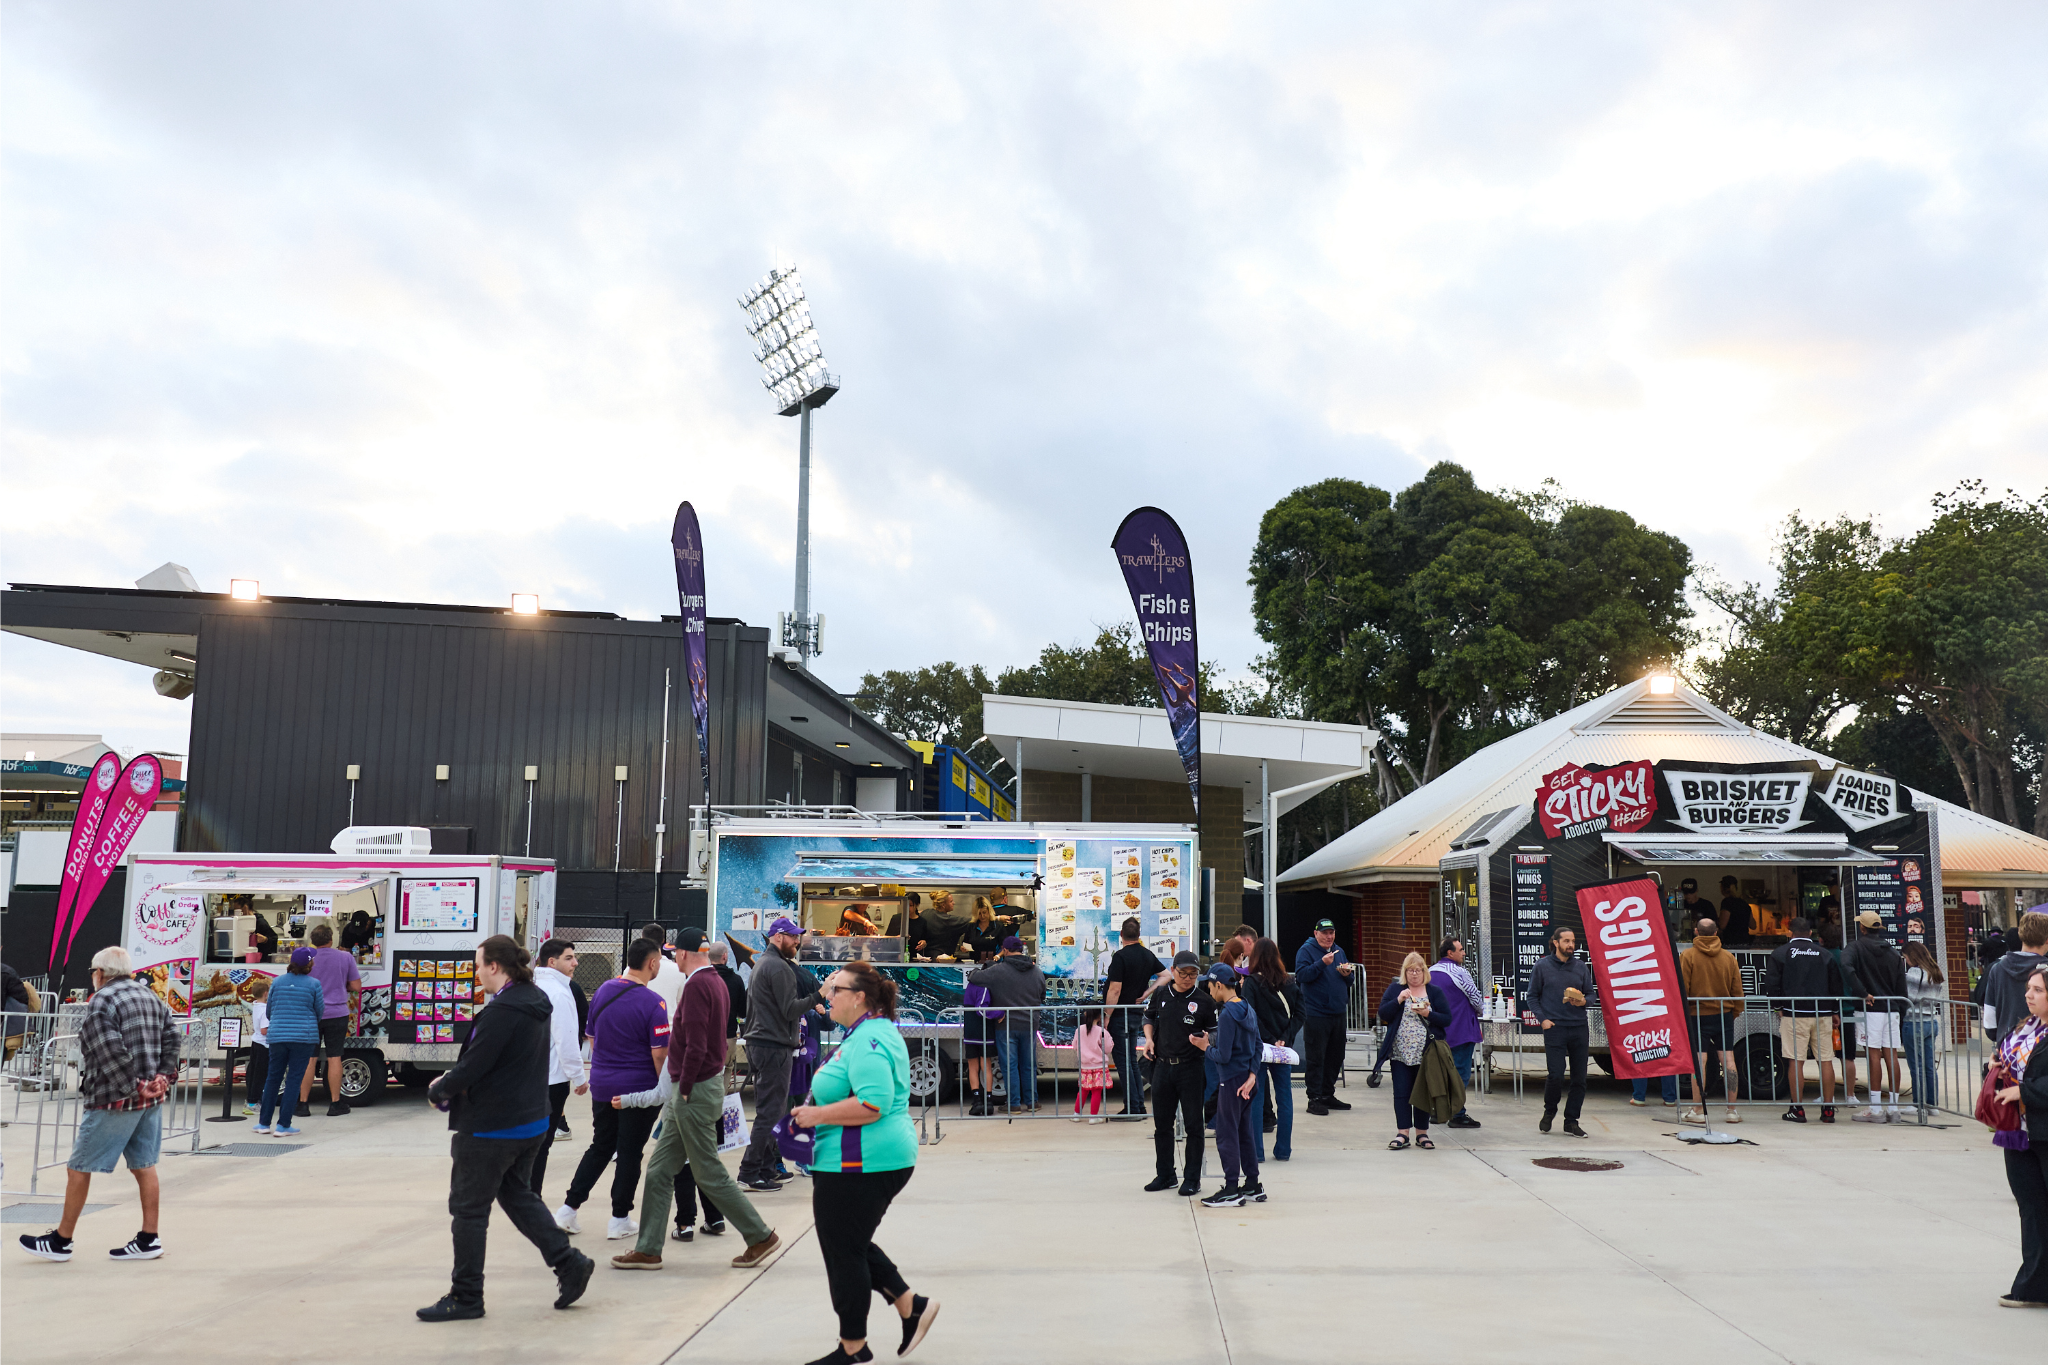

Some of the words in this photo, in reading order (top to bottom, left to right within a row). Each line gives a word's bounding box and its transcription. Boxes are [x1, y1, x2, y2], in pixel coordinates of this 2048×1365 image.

[682, 592, 704, 611] urgers
[1140, 594, 1176, 614] Fish
[1180, 599, 1190, 614] &
[1145, 622, 1192, 646] Chips
[63, 764, 80, 775] hbf
[1550, 768, 1579, 789] GET
[1681, 780, 1801, 801] BRISKET
[1836, 773, 1891, 797] LOADED
[1727, 800, 1750, 808] AND
[1831, 788, 1890, 817] FRIES
[1614, 807, 1650, 827] HERE
[1687, 808, 1791, 824] BURGERS
[67, 796, 103, 878] DONUTS
[94, 796, 138, 867] COFFEE
[1564, 817, 1608, 840] ADDICTION
[102, 868, 109, 877] &
[106, 849, 122, 869] HOT
[120, 807, 145, 845] DRINKS
[74, 851, 89, 882] BAKED
[86, 830, 97, 850] NOT
[1517, 873, 1542, 885] WINGS
[140, 899, 176, 924] Coffe
[1518, 909, 1549, 920] BURGERS
[166, 920, 187, 928] CAFE
[1518, 944, 1545, 955] LOADED
[1790, 948, 1820, 959] Yankees
[1594, 896, 1668, 1025] WINGS
[1634, 1045, 1669, 1063] ADDICTION
